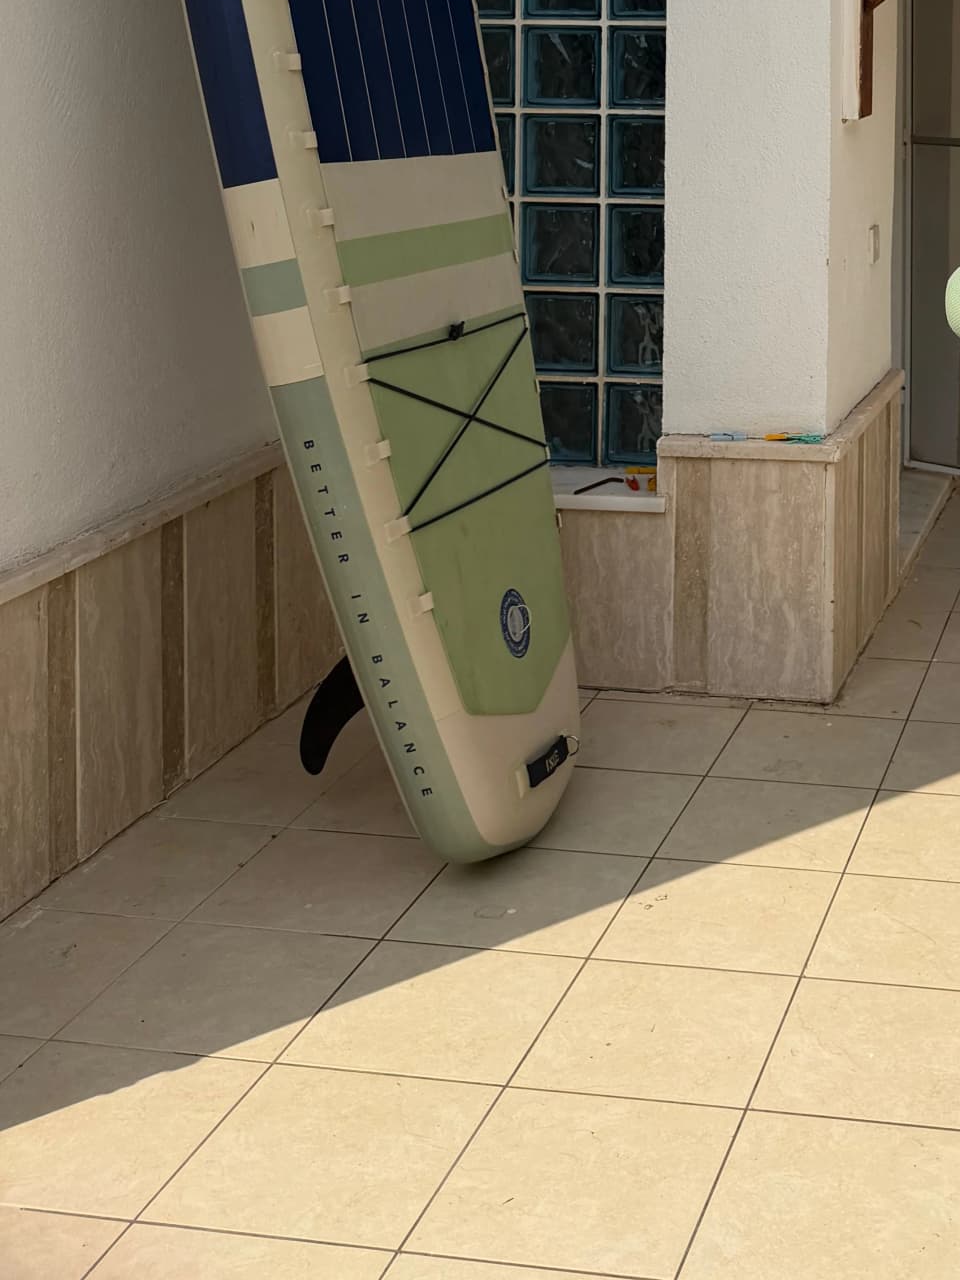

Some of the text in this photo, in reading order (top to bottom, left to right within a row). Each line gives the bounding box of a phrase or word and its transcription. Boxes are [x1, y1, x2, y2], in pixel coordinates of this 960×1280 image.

[303, 439, 433, 798] BETTER IN BALANCE
